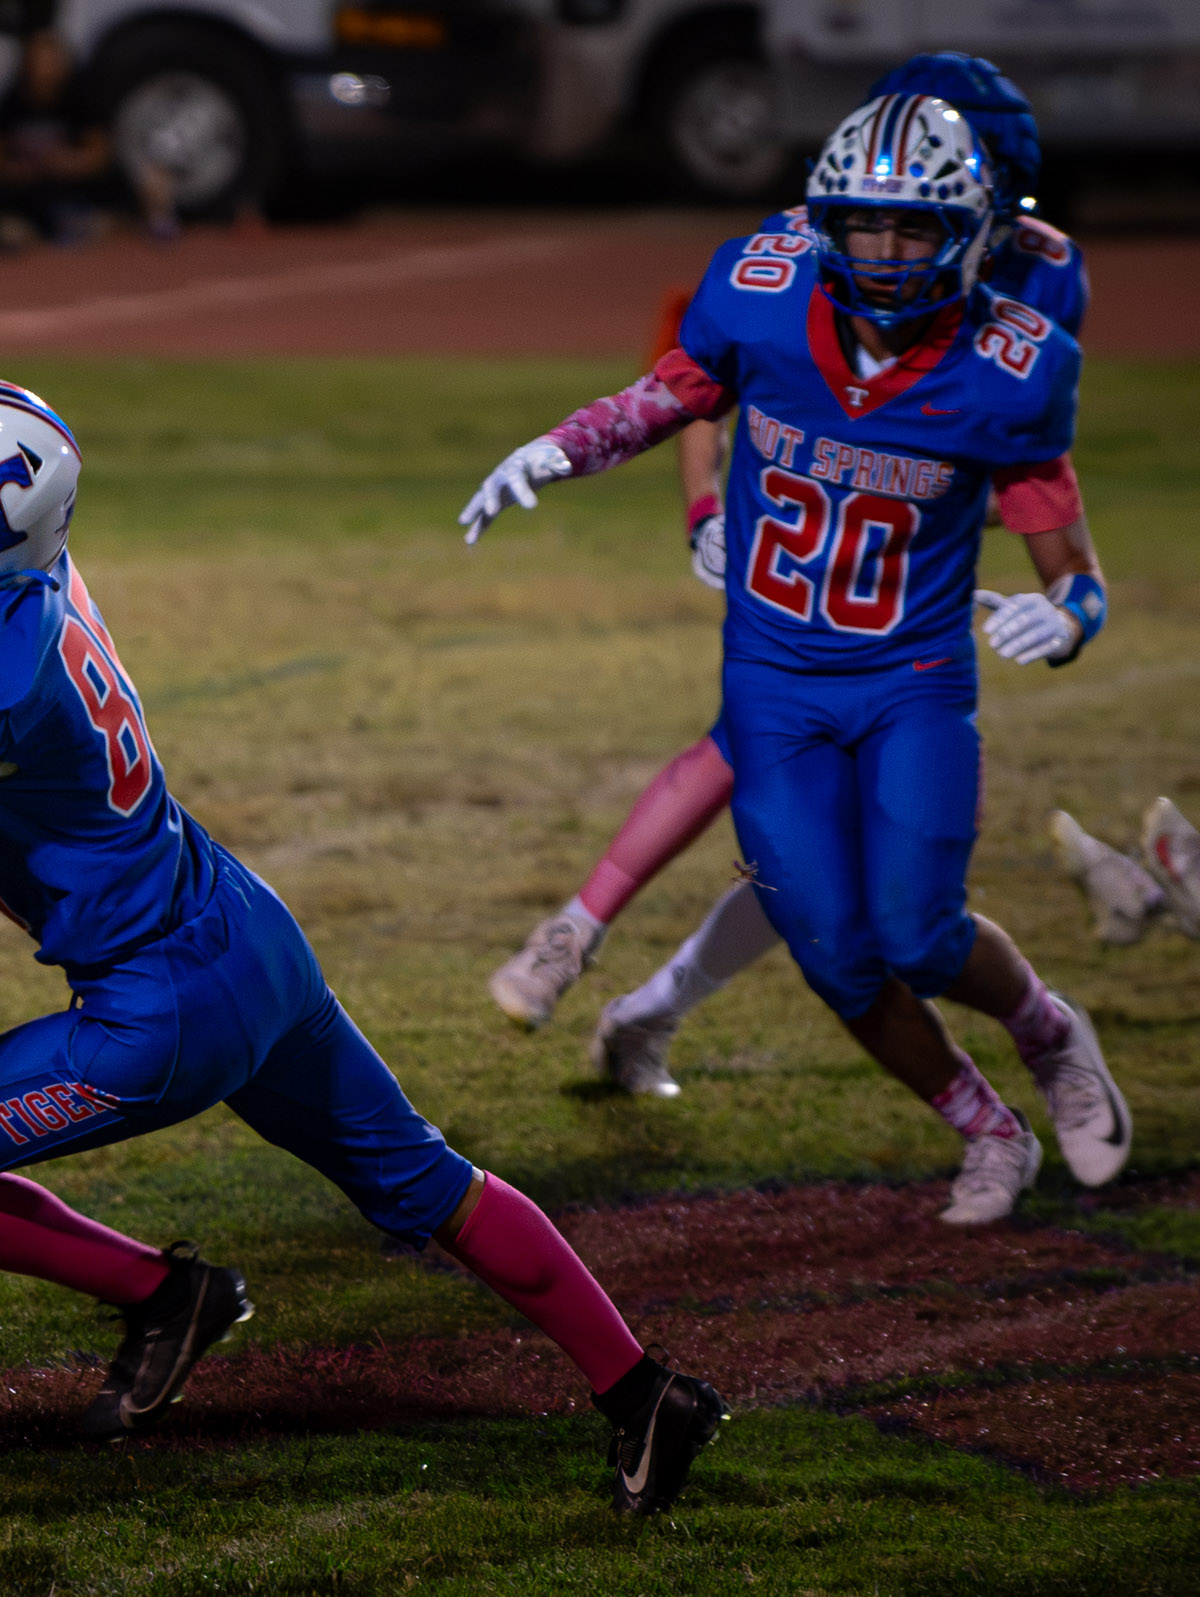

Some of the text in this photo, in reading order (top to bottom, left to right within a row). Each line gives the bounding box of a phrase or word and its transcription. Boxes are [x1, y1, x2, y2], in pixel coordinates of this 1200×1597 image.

[730, 232, 814, 293] 20
[974, 295, 1053, 380] 20
[845, 384, 870, 408] T
[809, 436, 955, 500] SPRINGS
[745, 465, 921, 637] 20
